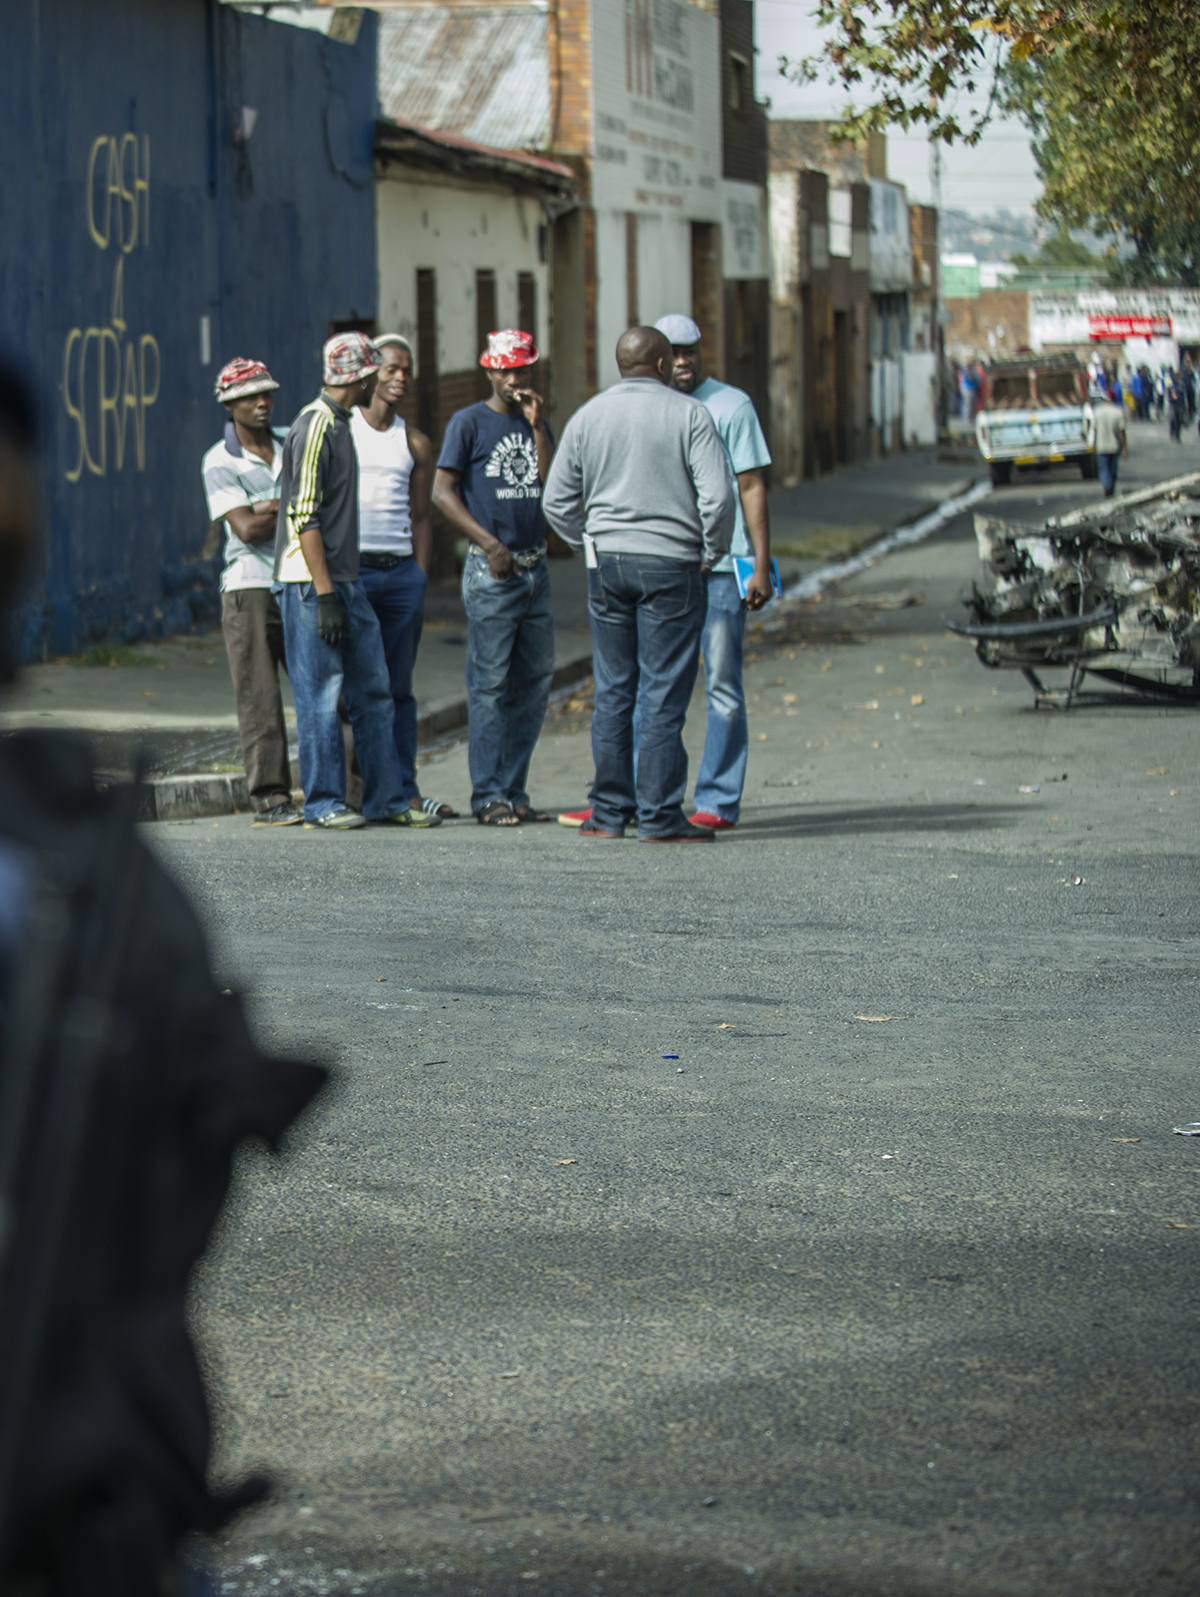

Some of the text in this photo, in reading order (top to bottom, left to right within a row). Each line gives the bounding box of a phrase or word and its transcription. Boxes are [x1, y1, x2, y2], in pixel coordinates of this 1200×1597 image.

[86, 133, 150, 253] CASH
[64, 328, 160, 482] SCRAP
[495, 487, 541, 500] WORLD TOU
